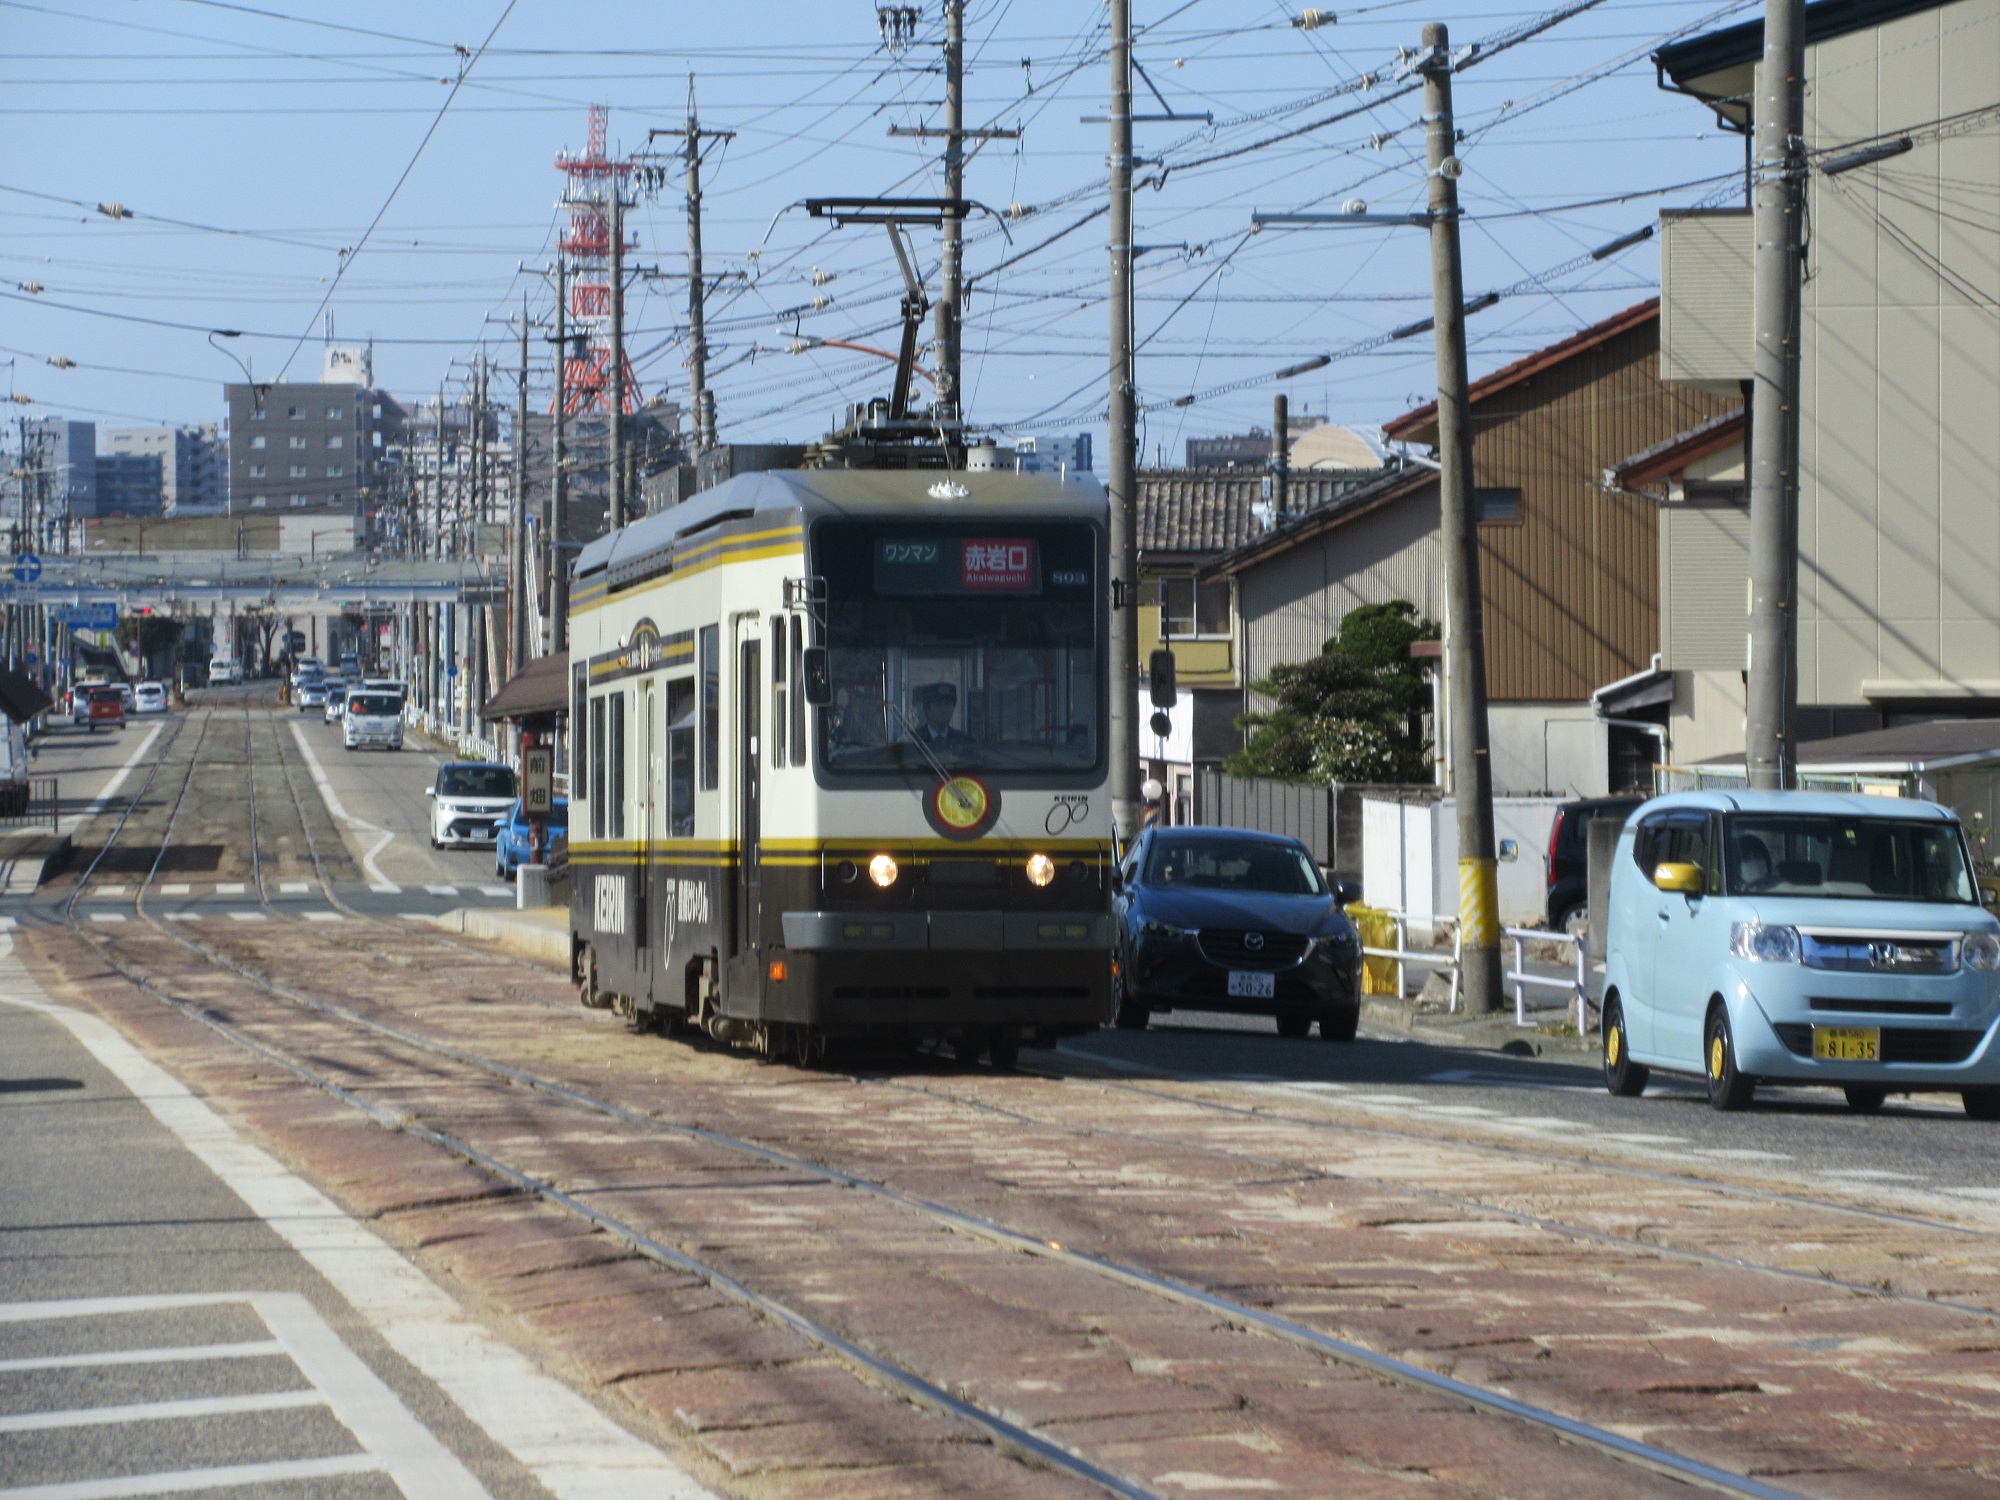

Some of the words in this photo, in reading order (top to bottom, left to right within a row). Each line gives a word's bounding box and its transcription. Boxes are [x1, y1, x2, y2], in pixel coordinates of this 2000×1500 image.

[885, 544, 936, 562] ワンマン
[965, 544, 1028, 572] 赤岩口
[966, 573, 1026, 583] Akaiwaguchi
[529, 756, 546, 805] 前畑
[1053, 794, 1089, 802] KEIRIN
[594, 874, 625, 935] KEIRIN
[1828, 1040, 1875, 1058] 81-35
